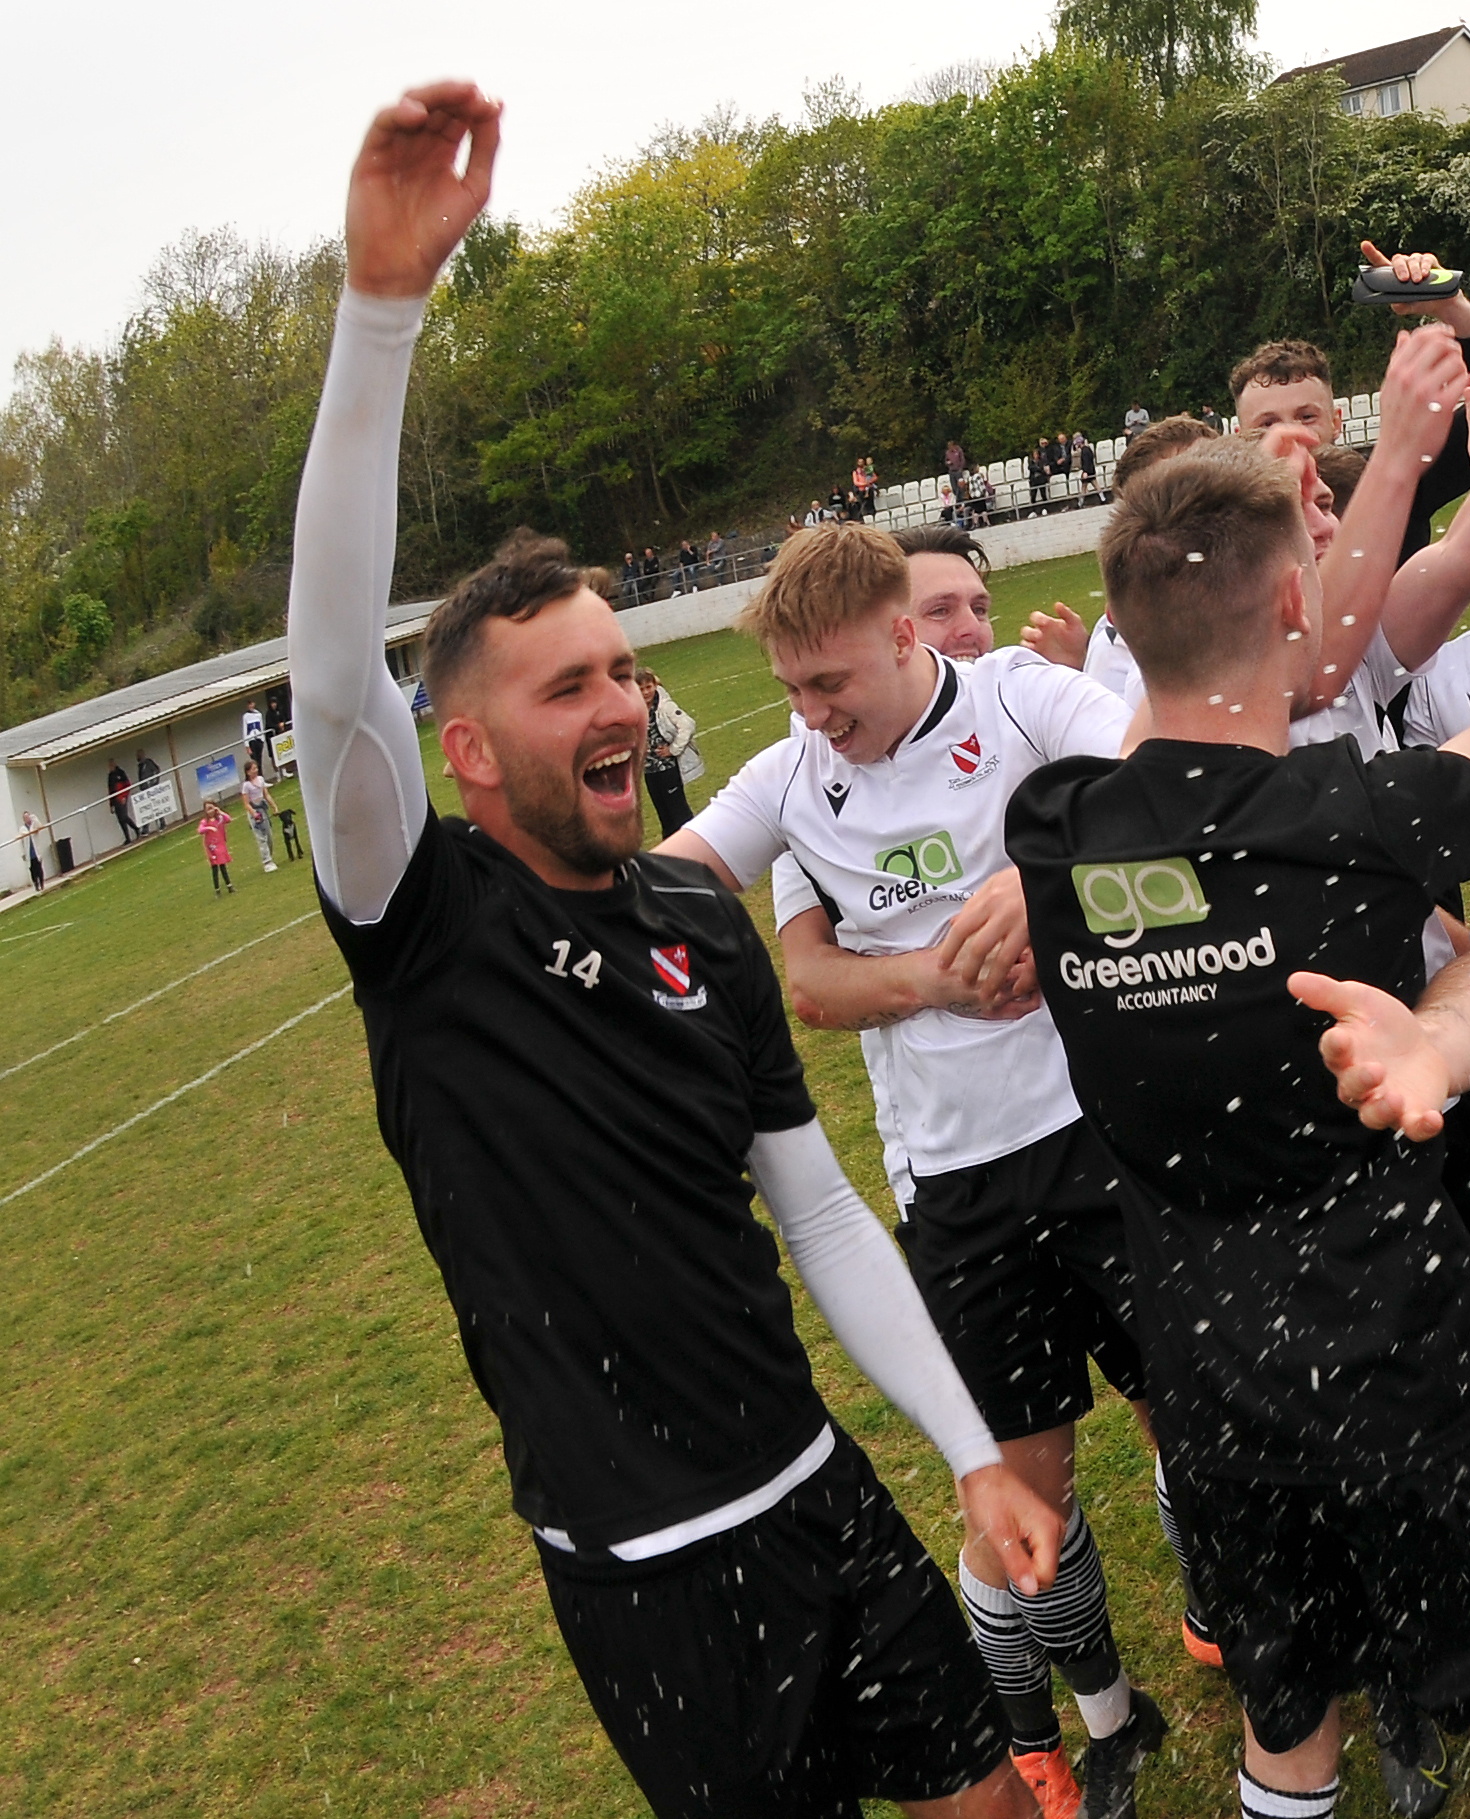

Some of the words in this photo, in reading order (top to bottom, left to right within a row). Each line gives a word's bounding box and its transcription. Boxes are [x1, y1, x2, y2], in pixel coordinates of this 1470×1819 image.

[1084, 865, 1197, 949] ga
[544, 939, 602, 989] 14
[1060, 926, 1277, 990] Greenwood
[1117, 983, 1218, 1012] ACCOUNTANCY
